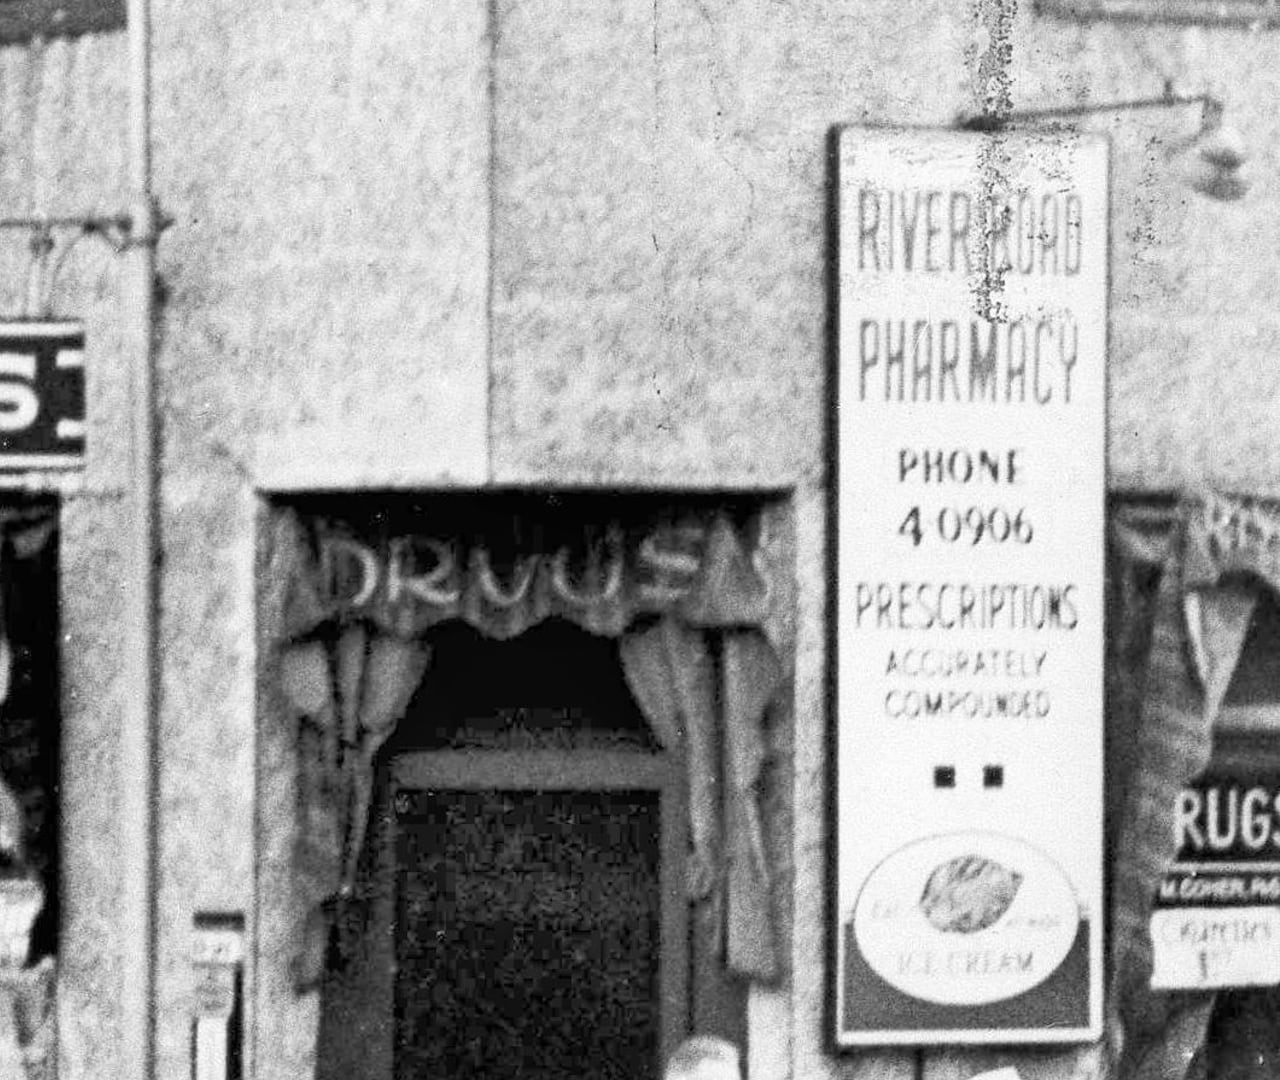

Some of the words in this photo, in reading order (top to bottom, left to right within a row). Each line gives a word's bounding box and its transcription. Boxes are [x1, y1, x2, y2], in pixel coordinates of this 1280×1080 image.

[858, 188, 972, 273] RIVER
[858, 317, 1079, 405] PHARMACY
[898, 449, 1021, 484] PHONE
[937, 505, 1034, 547] 0906
[856, 581, 1079, 631] PRESCRIPTIONS
[885, 649, 1048, 677] ACCURATELY
[884, 688, 1051, 719] COMPOUNDED
